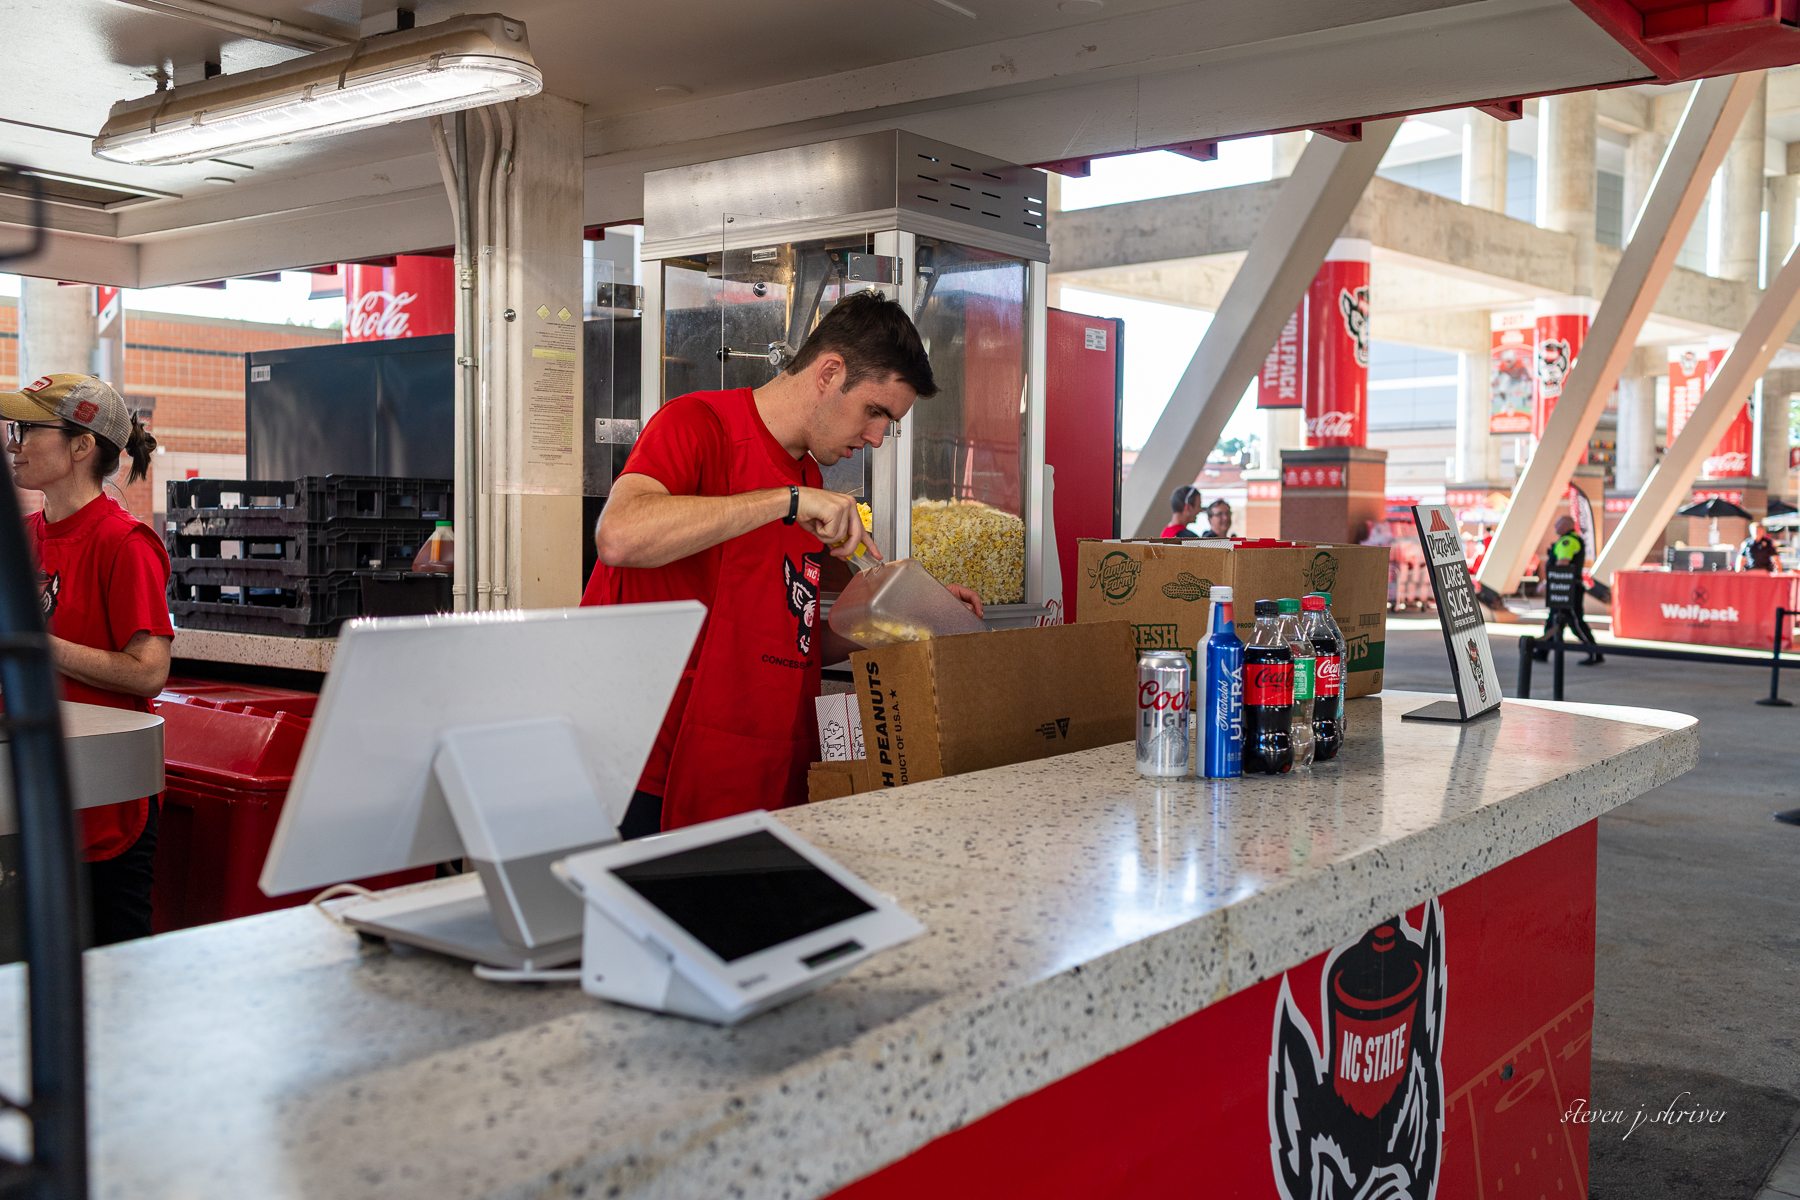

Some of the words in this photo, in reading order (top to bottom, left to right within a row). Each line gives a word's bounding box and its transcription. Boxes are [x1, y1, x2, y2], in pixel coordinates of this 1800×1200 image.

[1427, 533, 1448, 559] Pizza
[1445, 532, 1461, 556] Hut
[1089, 557, 1142, 596] Hampton
[1103, 572, 1138, 594] Farms
[1440, 563, 1466, 590] LARGE
[1548, 571, 1574, 580] Please
[1549, 582, 1571, 591] Enter
[1447, 587, 1474, 618] SLICE
[1550, 593, 1570, 602] Here
[1660, 602, 1739, 622] Wolfpack
[1131, 624, 1178, 649] RESH
[762, 654, 806, 670] CONCESS
[1317, 659, 1340, 679] Coca
[866, 661, 892, 766] PEANUTS
[892, 700, 902, 733] U.S.A.
[1215, 680, 1229, 731] Michelob
[1230, 666, 1243, 741] ULTRA
[1143, 711, 1188, 728] LIGH
[896, 734, 905, 750] OF
[898, 752, 909, 785] DUCT
[1340, 1030, 1362, 1083] NC
[1363, 1022, 1407, 1083] STATE
